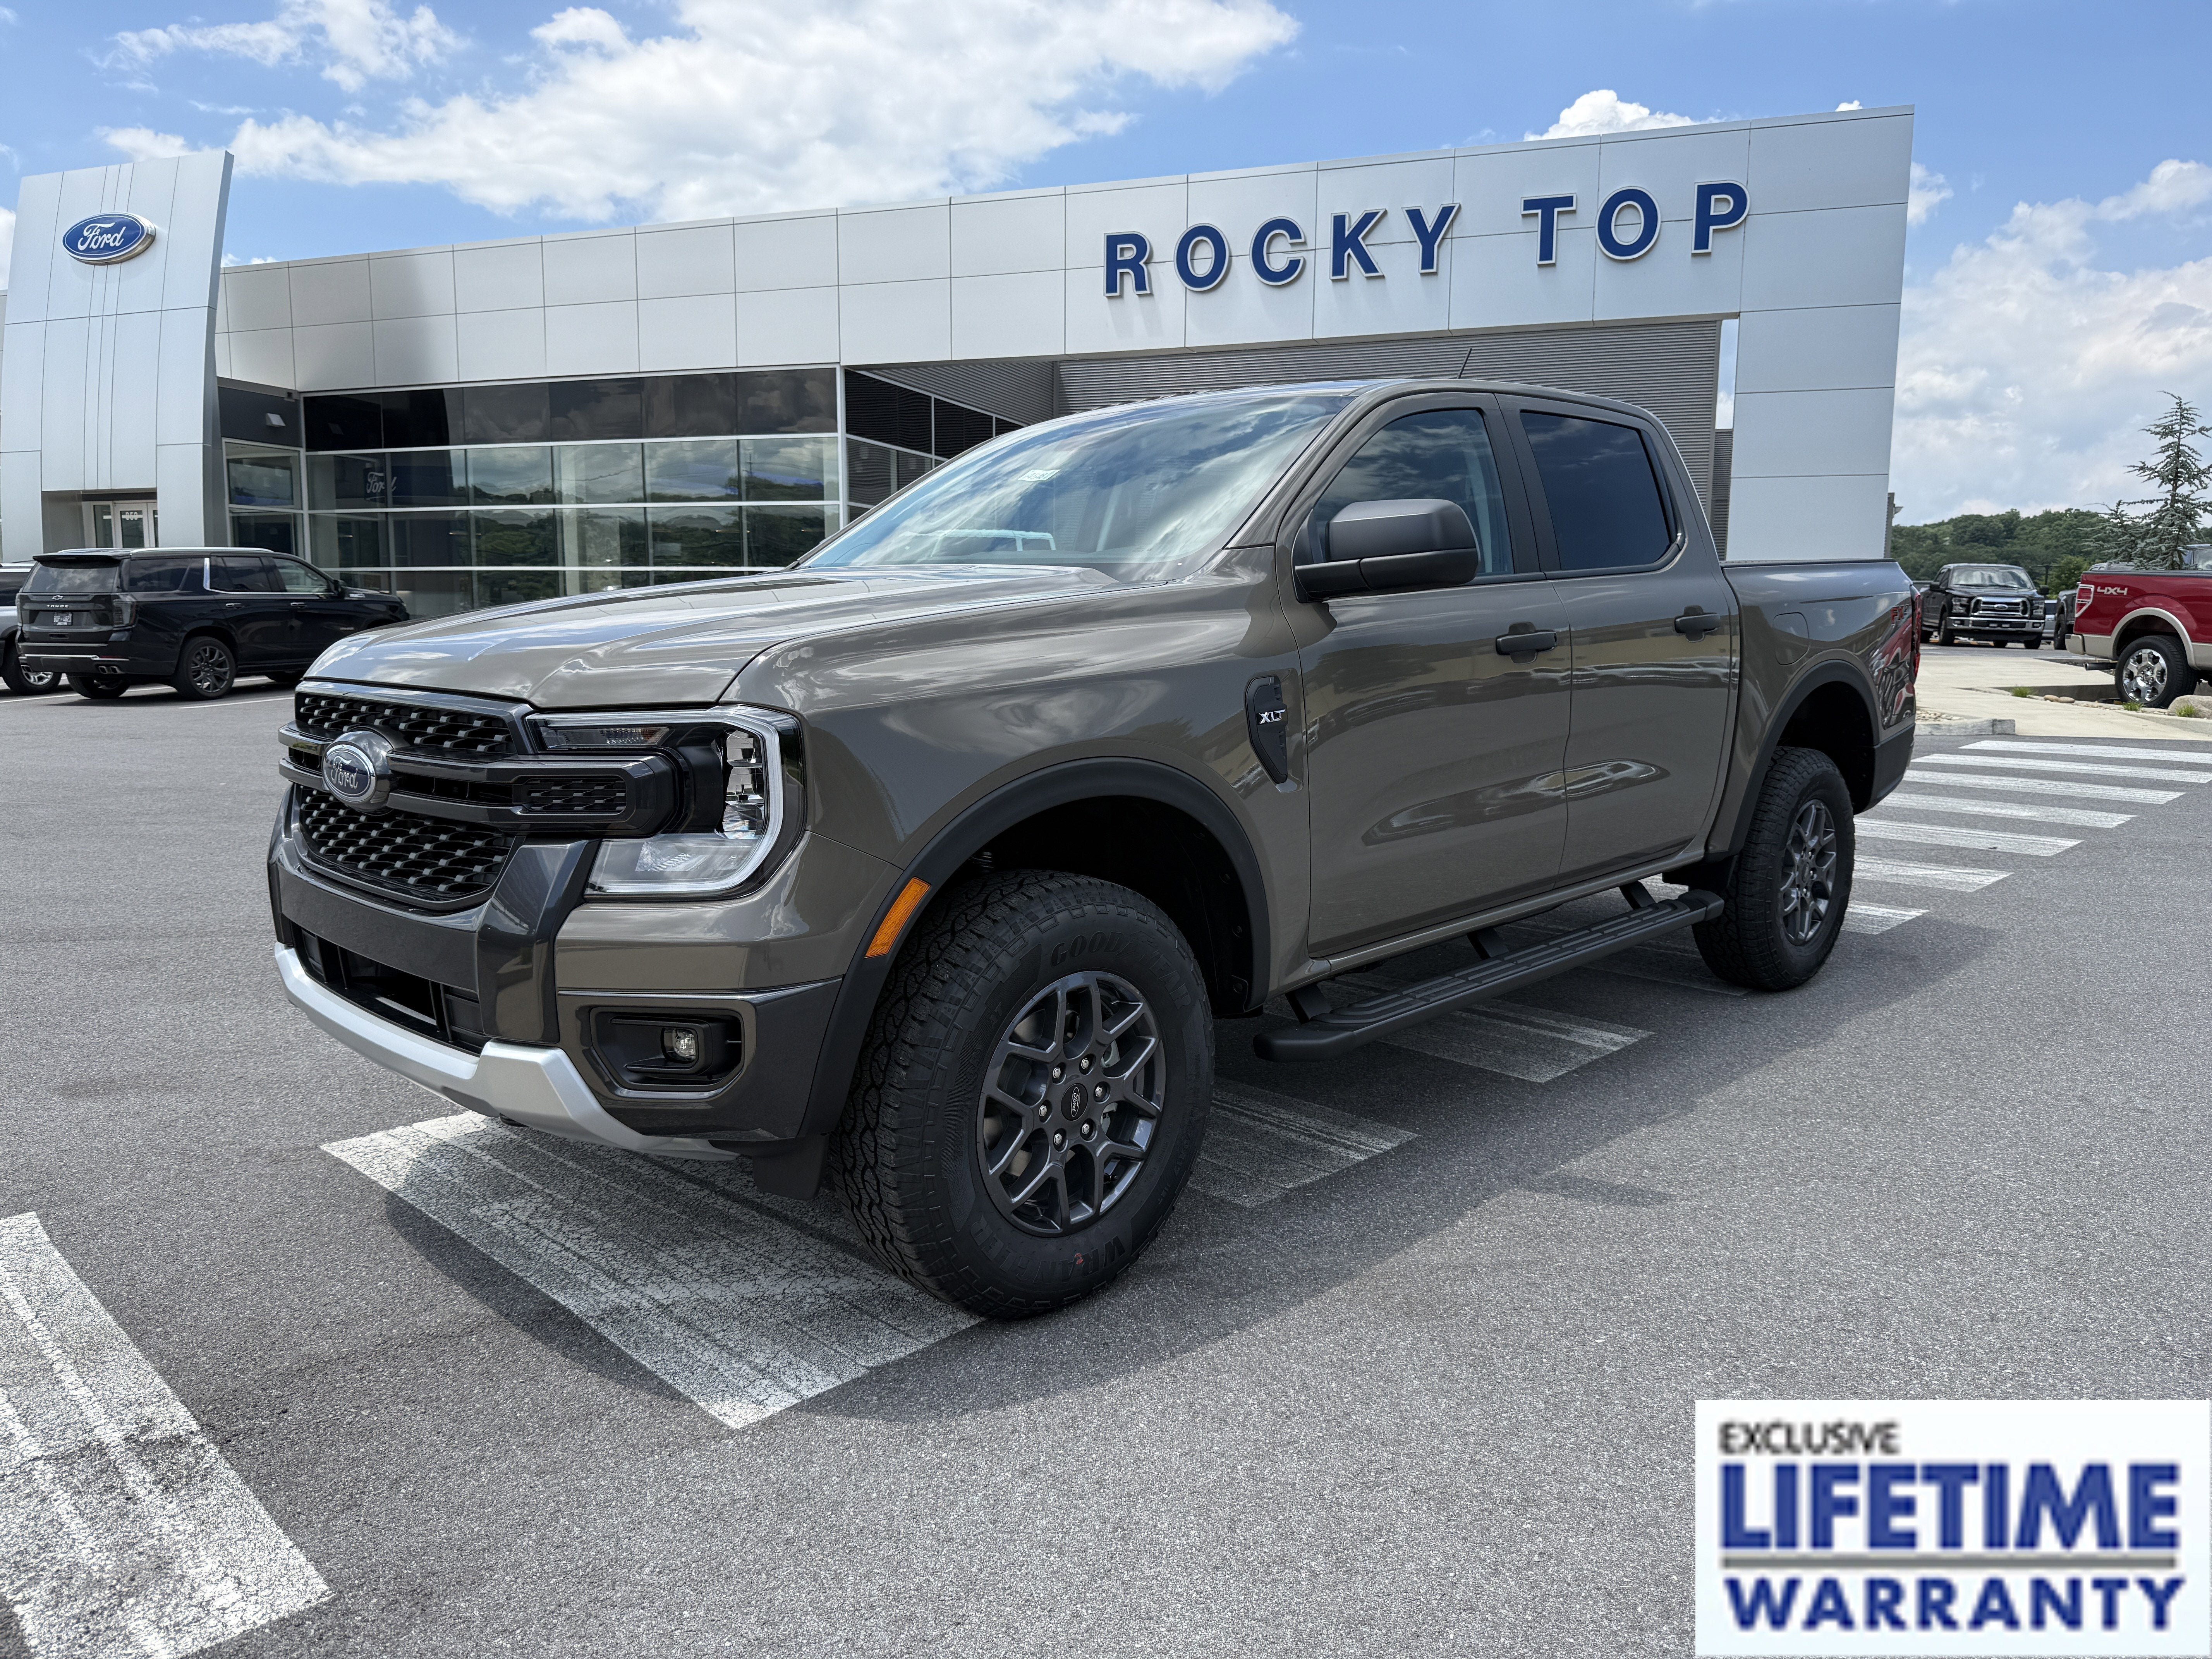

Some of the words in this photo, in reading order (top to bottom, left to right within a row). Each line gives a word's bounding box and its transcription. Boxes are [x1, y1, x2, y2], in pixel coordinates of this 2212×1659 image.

[77, 222, 127, 251] Ford
[1104, 203, 1460, 298] ROCKY
[1520, 180, 1750, 266] TOP
[2097, 586, 2128, 596] 4X4
[1259, 709, 1286, 724] XLT
[331, 756, 358, 789] Ford
[1051, 931, 1192, 1010] GOODYEAR
[986, 1001, 1006, 1029] AT
[970, 1214, 1125, 1283] WRANGLER
